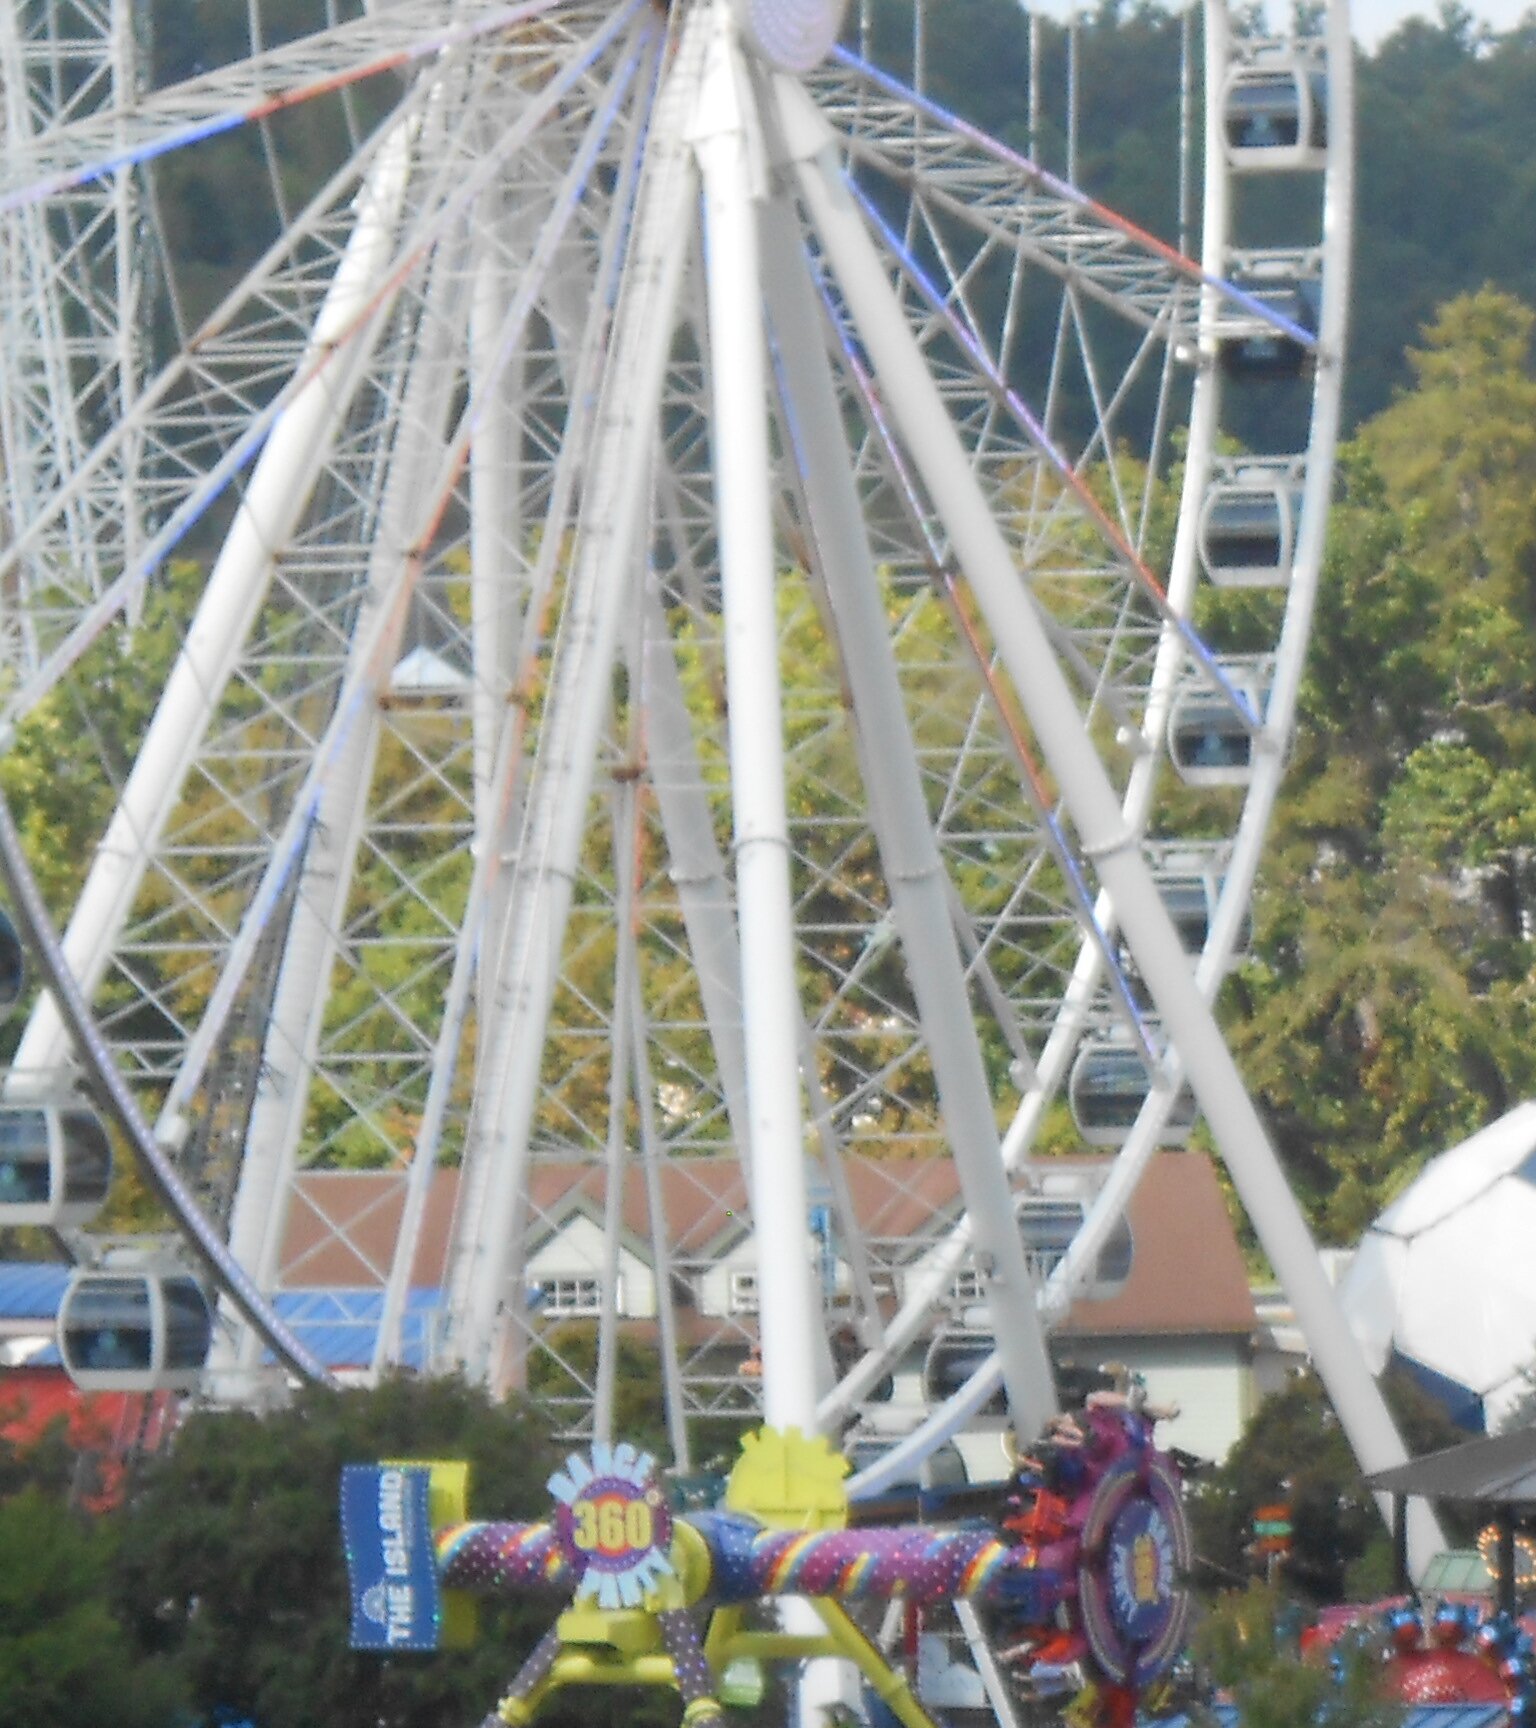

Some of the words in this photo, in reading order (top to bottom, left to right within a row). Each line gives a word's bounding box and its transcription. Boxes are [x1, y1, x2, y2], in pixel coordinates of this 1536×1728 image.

[546, 1442, 656, 1507] DANCE
[378, 1470, 408, 1576] ISLAND
[574, 1546, 674, 1609] PARTY
[386, 1583, 413, 1647] THE
